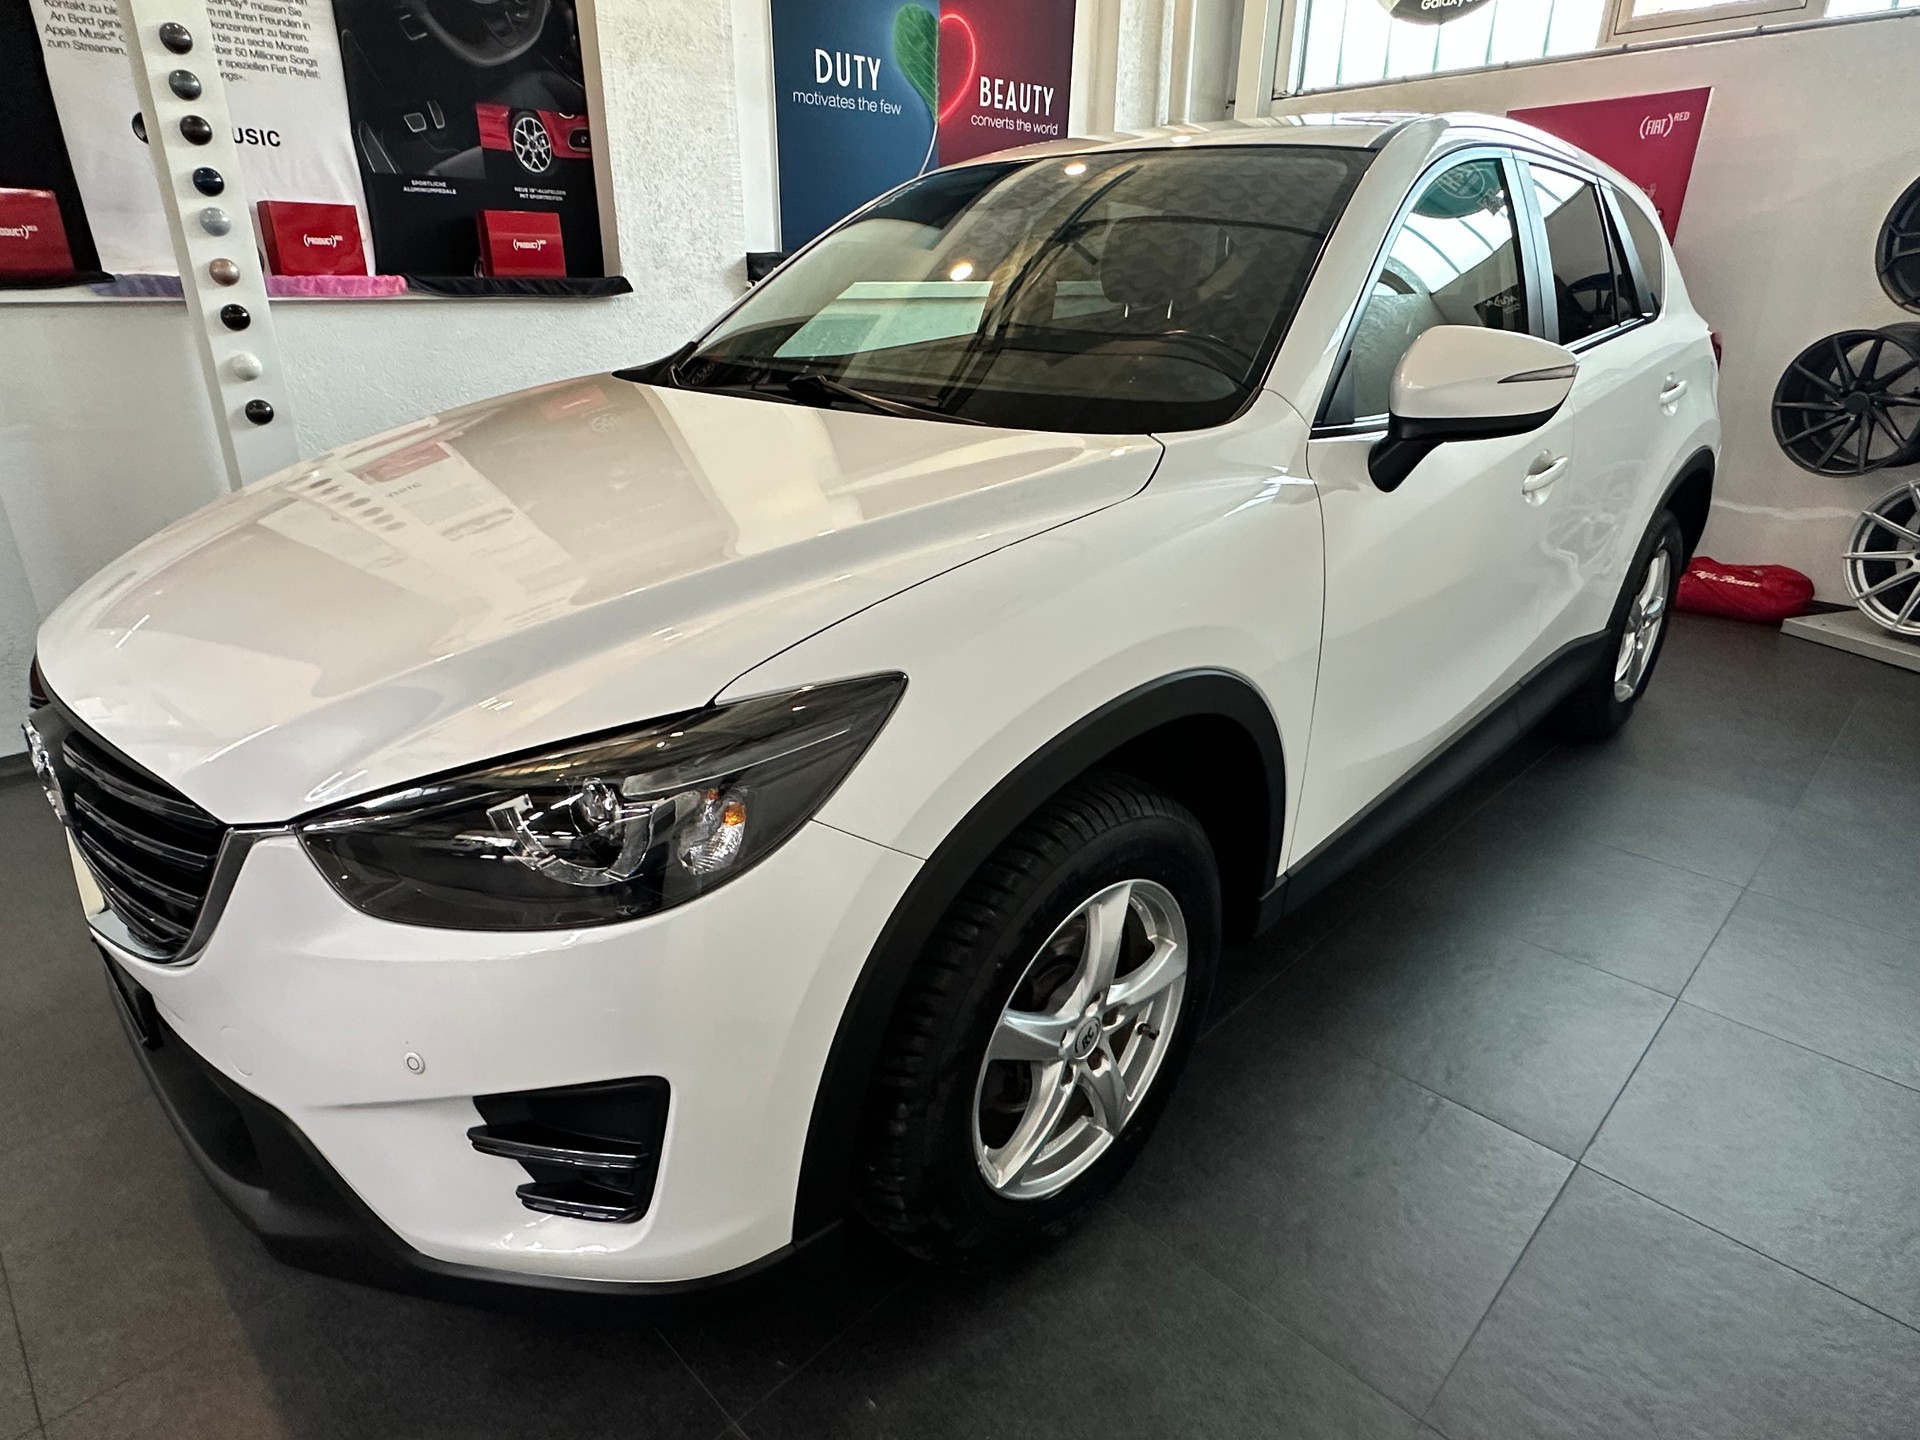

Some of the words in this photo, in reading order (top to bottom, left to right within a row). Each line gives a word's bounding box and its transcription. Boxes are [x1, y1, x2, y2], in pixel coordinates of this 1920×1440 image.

[217, 9, 233, 19] mit
[234, 10, 257, 22] Ihren
[259, 14, 301, 29] Freunden
[302, 21, 311, 30] in
[250, 2, 287, 15] müssen
[288, 6, 302, 17] Sie
[1421, 0, 1463, 10] Galaxy
[50, 11, 66, 22] An
[67, 13, 95, 26] Bord
[217, 34, 231, 43] bis
[233, 35, 246, 45] zu
[247, 37, 274, 49] sechs
[275, 40, 309, 54] Monate
[88, 4, 102, 13] zu
[210, 18, 264, 36] konzentriert
[266, 28, 278, 38] zu
[279, 29, 310, 42] fahren.
[45, 23, 77, 37] Apple
[234, 46, 248, 57] 50
[249, 48, 288, 63] Millionen
[289, 54, 319, 68] Songs
[47, 39, 71, 49] zum
[225, 60, 269, 73] speziellen
[270, 64, 288, 75] Fiat
[815, 48, 881, 91] DUTY
[792, 91, 856, 110] motivates
[858, 97, 878, 113] the
[880, 99, 902, 115] few
[979, 75, 1054, 117] BEAUTY
[970, 114, 1015, 130] converts
[1016, 118, 1032, 132] the
[1033, 122, 1058, 136] world
[1674, 111, 1691, 122] RED
